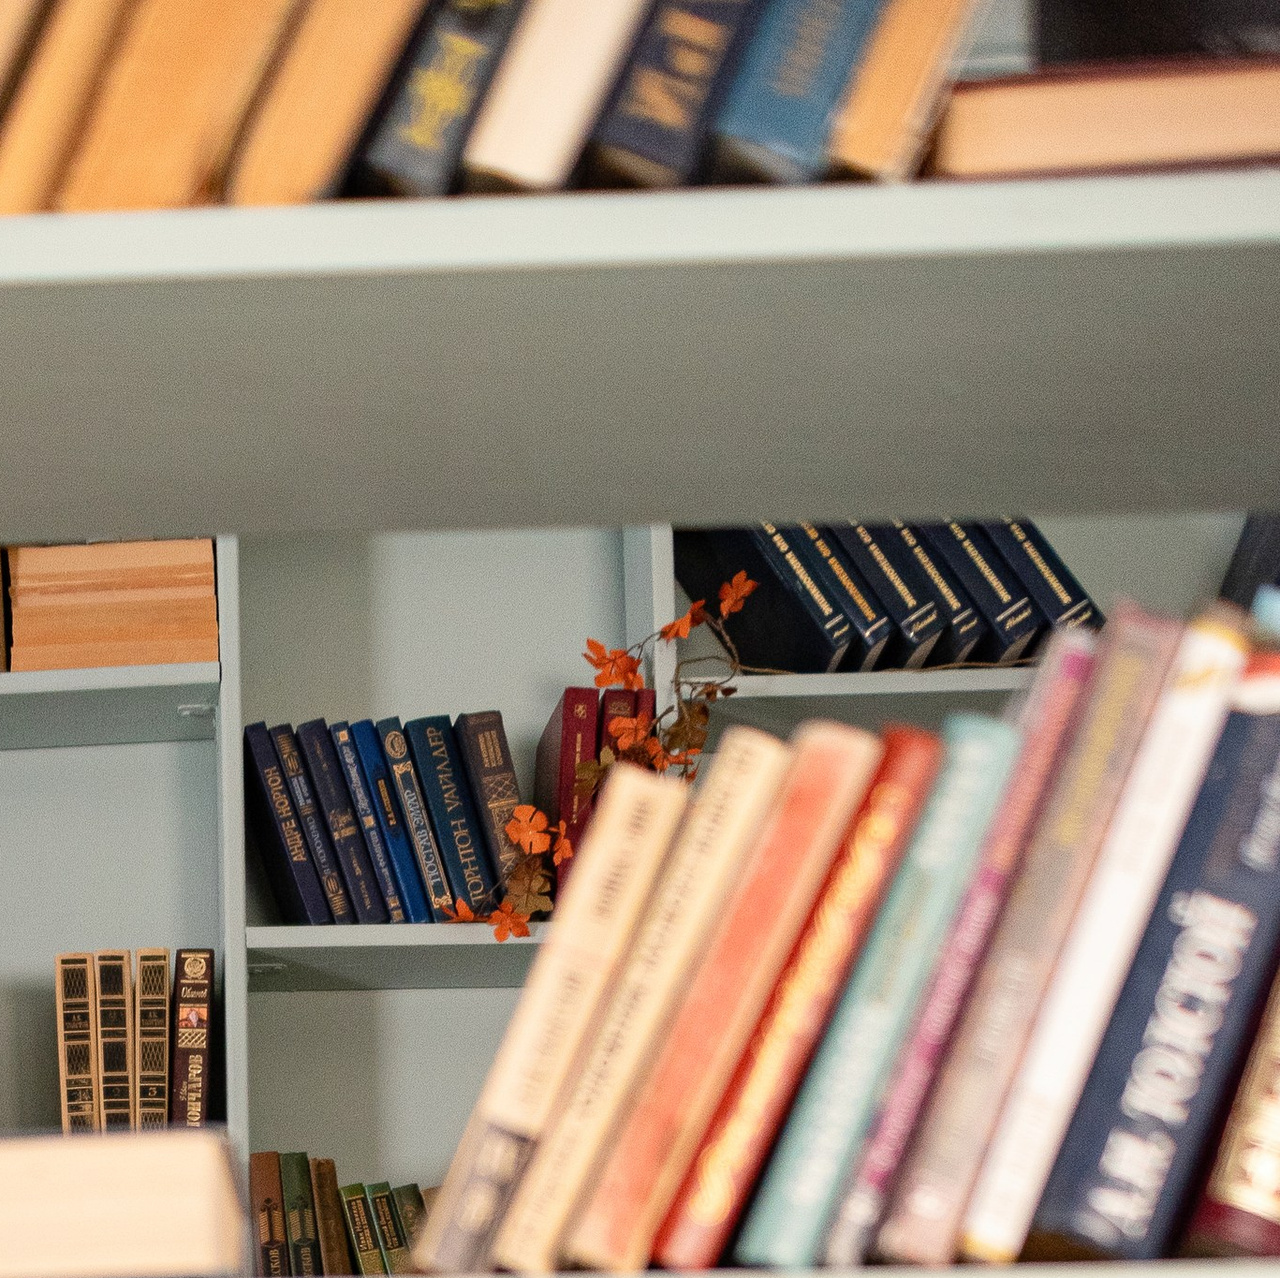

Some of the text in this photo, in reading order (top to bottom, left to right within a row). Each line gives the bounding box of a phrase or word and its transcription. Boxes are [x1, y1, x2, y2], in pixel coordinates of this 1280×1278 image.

[264, 765, 292, 818] НОРТОН
[426, 725, 485, 905] ТОРНТОН УАЙЛДЕР
[282, 817, 307, 863] АНДРЕ
[405, 787, 442, 885] ГЮСТАВ ЭМАР
